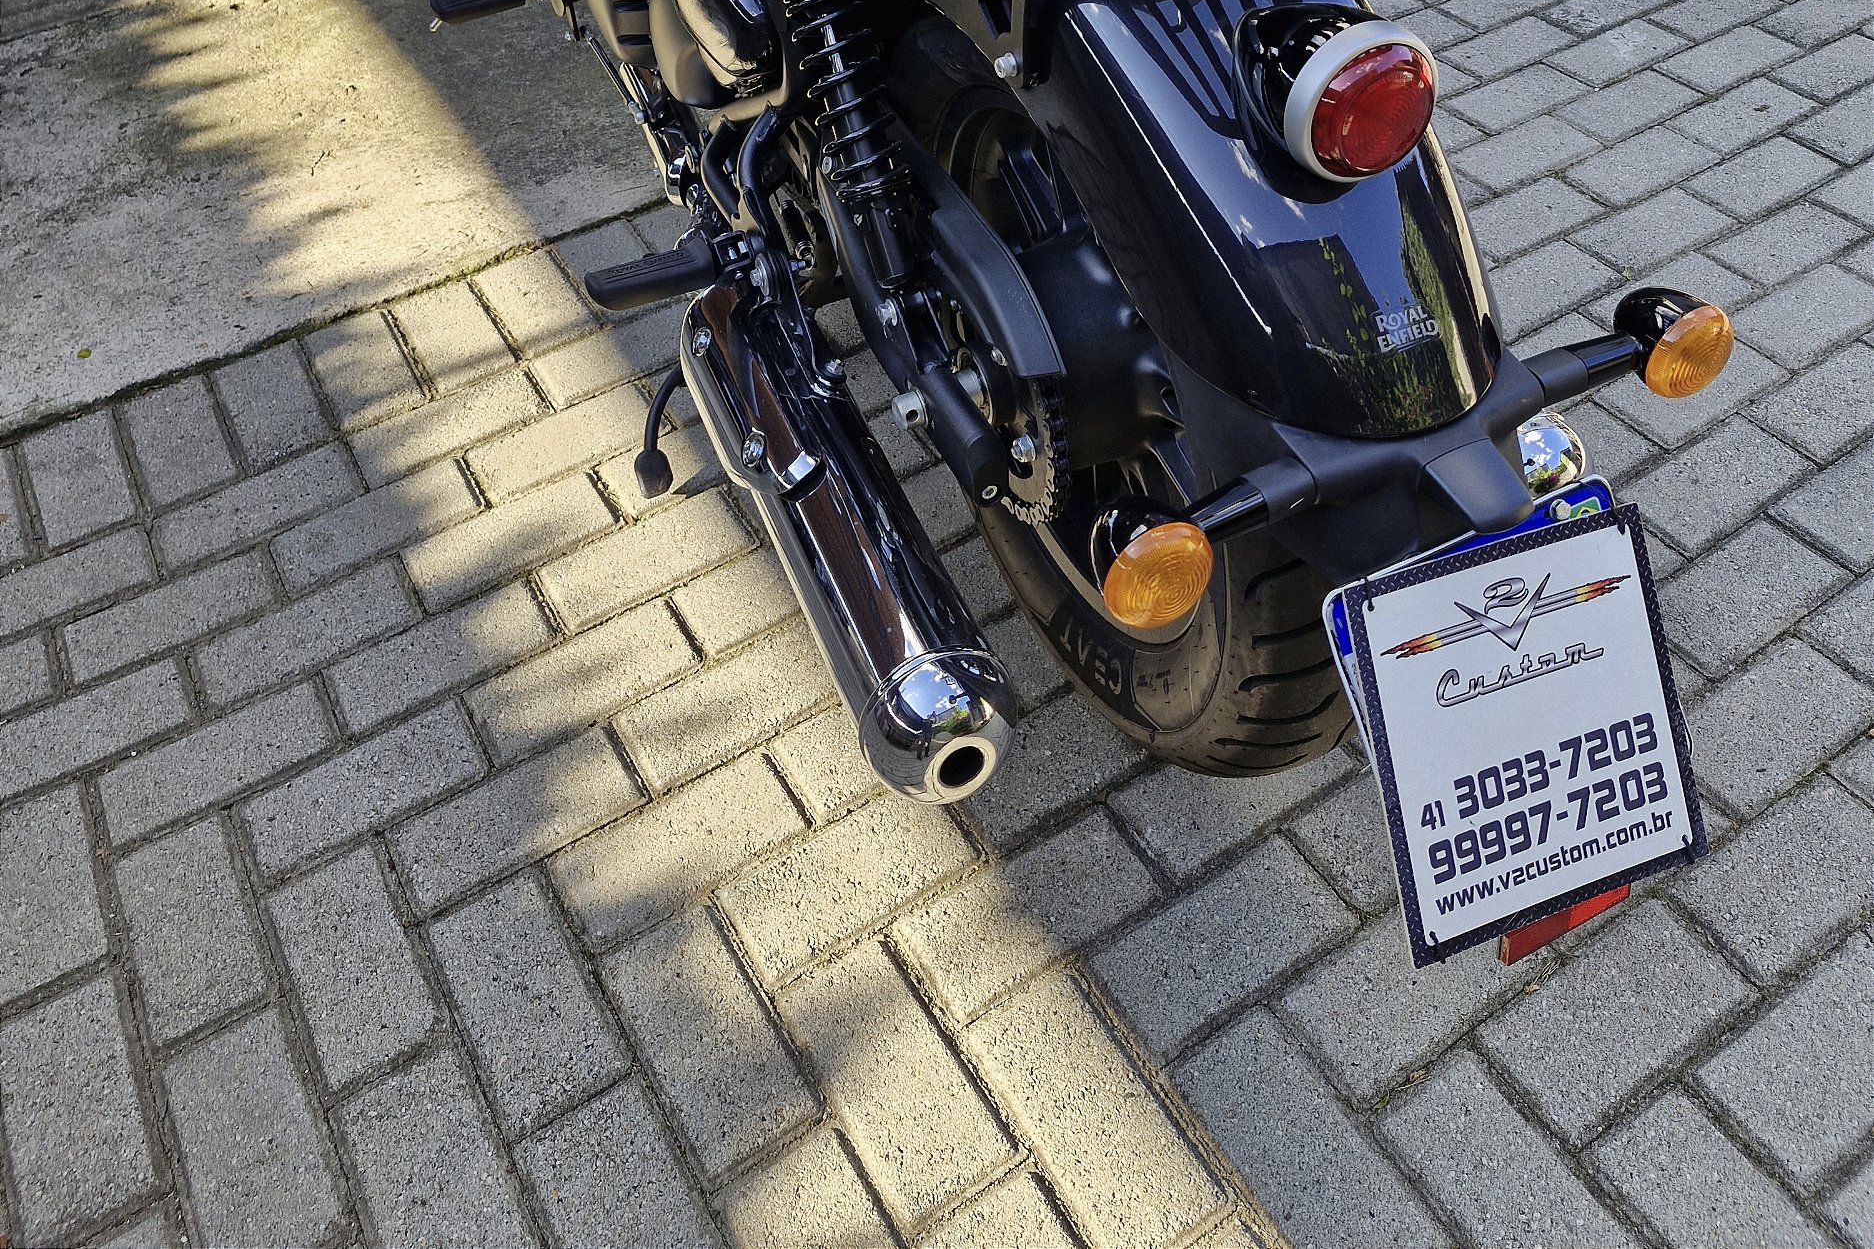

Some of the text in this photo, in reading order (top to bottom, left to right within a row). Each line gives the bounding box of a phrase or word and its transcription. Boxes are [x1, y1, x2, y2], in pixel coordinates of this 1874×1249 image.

[1375, 305, 1428, 332] ROYAL
[1377, 319, 1438, 352] ENFIELD
[1437, 642, 1604, 708] Custom
[1421, 713, 1658, 831] 41 3033-7203
[1429, 762, 1669, 885] 99997-7203
[1436, 808, 1673, 916] www.v2custom.com.br
